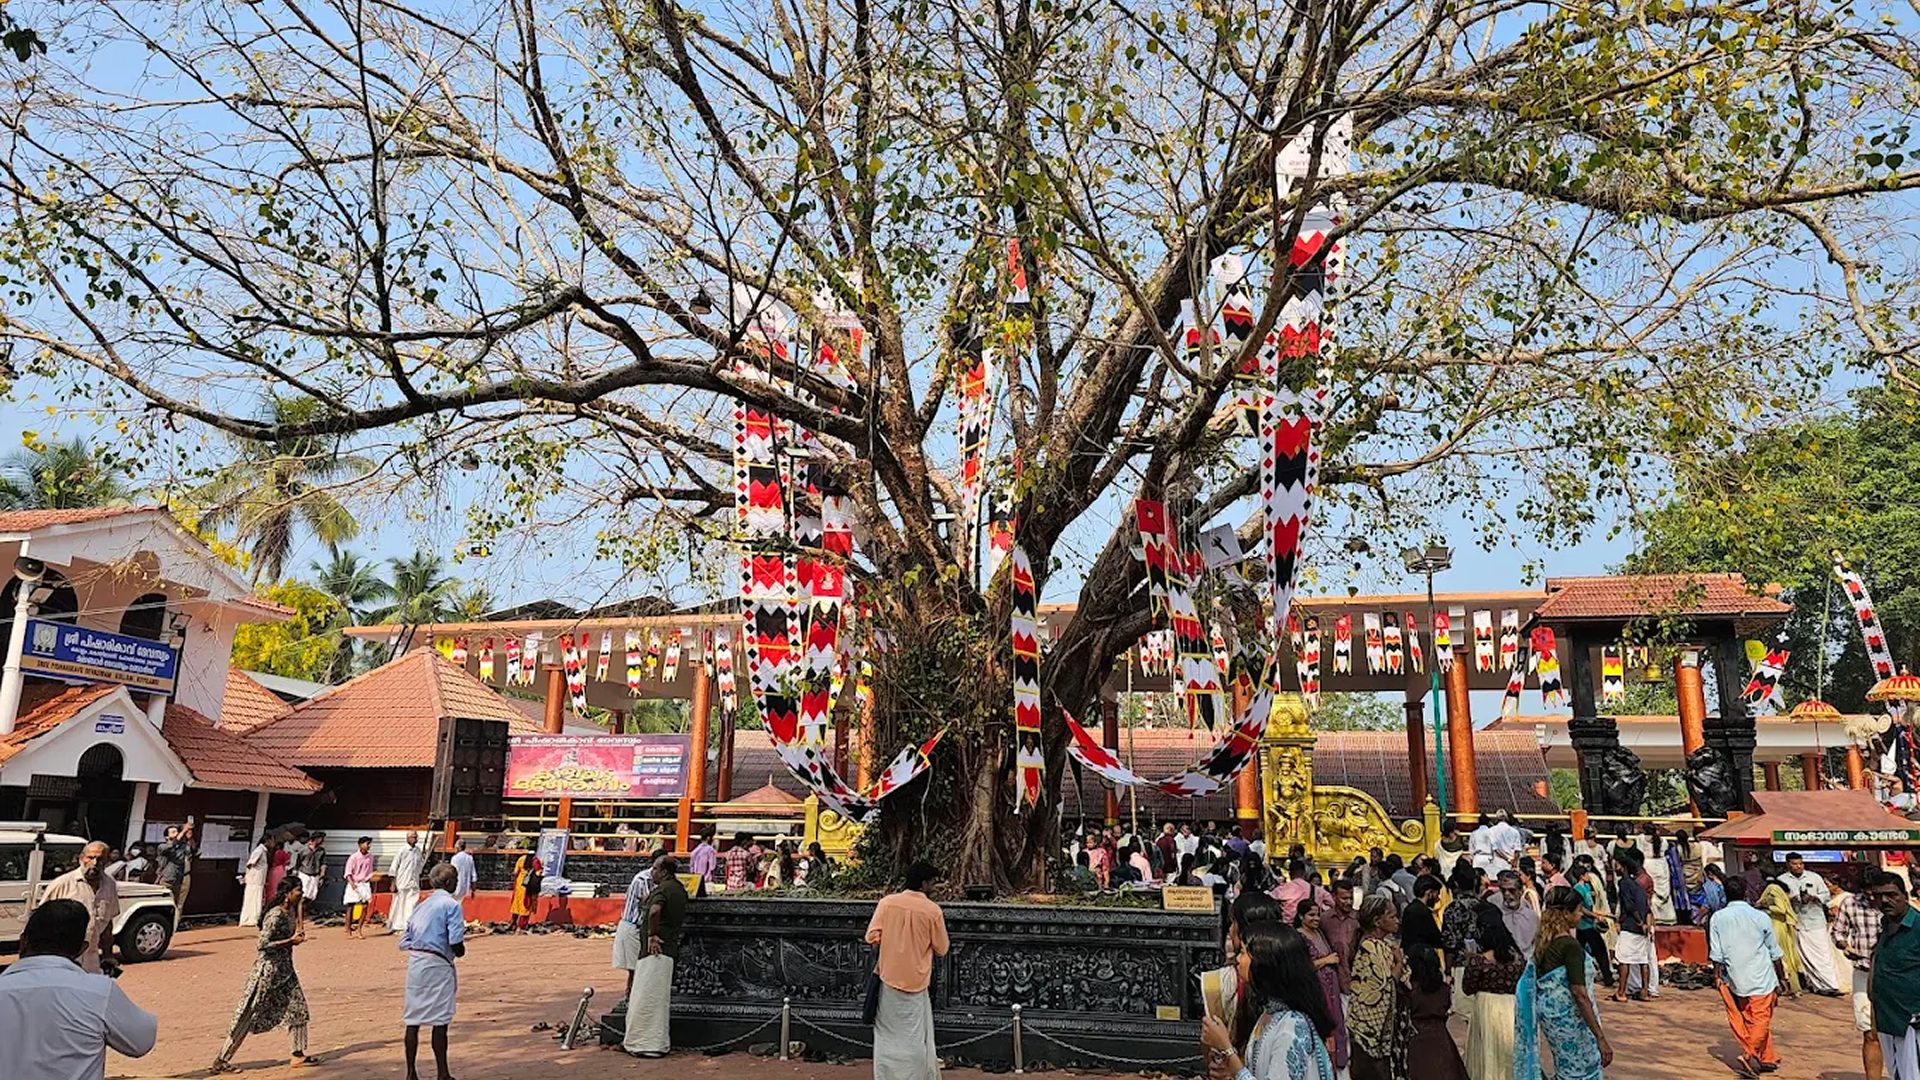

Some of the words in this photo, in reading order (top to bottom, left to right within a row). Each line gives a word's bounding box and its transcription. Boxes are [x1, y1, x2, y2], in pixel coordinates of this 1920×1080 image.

[64, 632, 80, 647] ശ്രീ
[80, 634, 137, 655] പിഷാരികാവ്
[137, 647, 170, 662] ദേവസ്വം
[525, 737, 593, 745] പിഷാരികാവ്
[597, 737, 642, 745] ദേവസ്വം
[1784, 832, 1849, 841] സംഭാവന
[1853, 831, 1909, 841] കൗണ്ടർ
